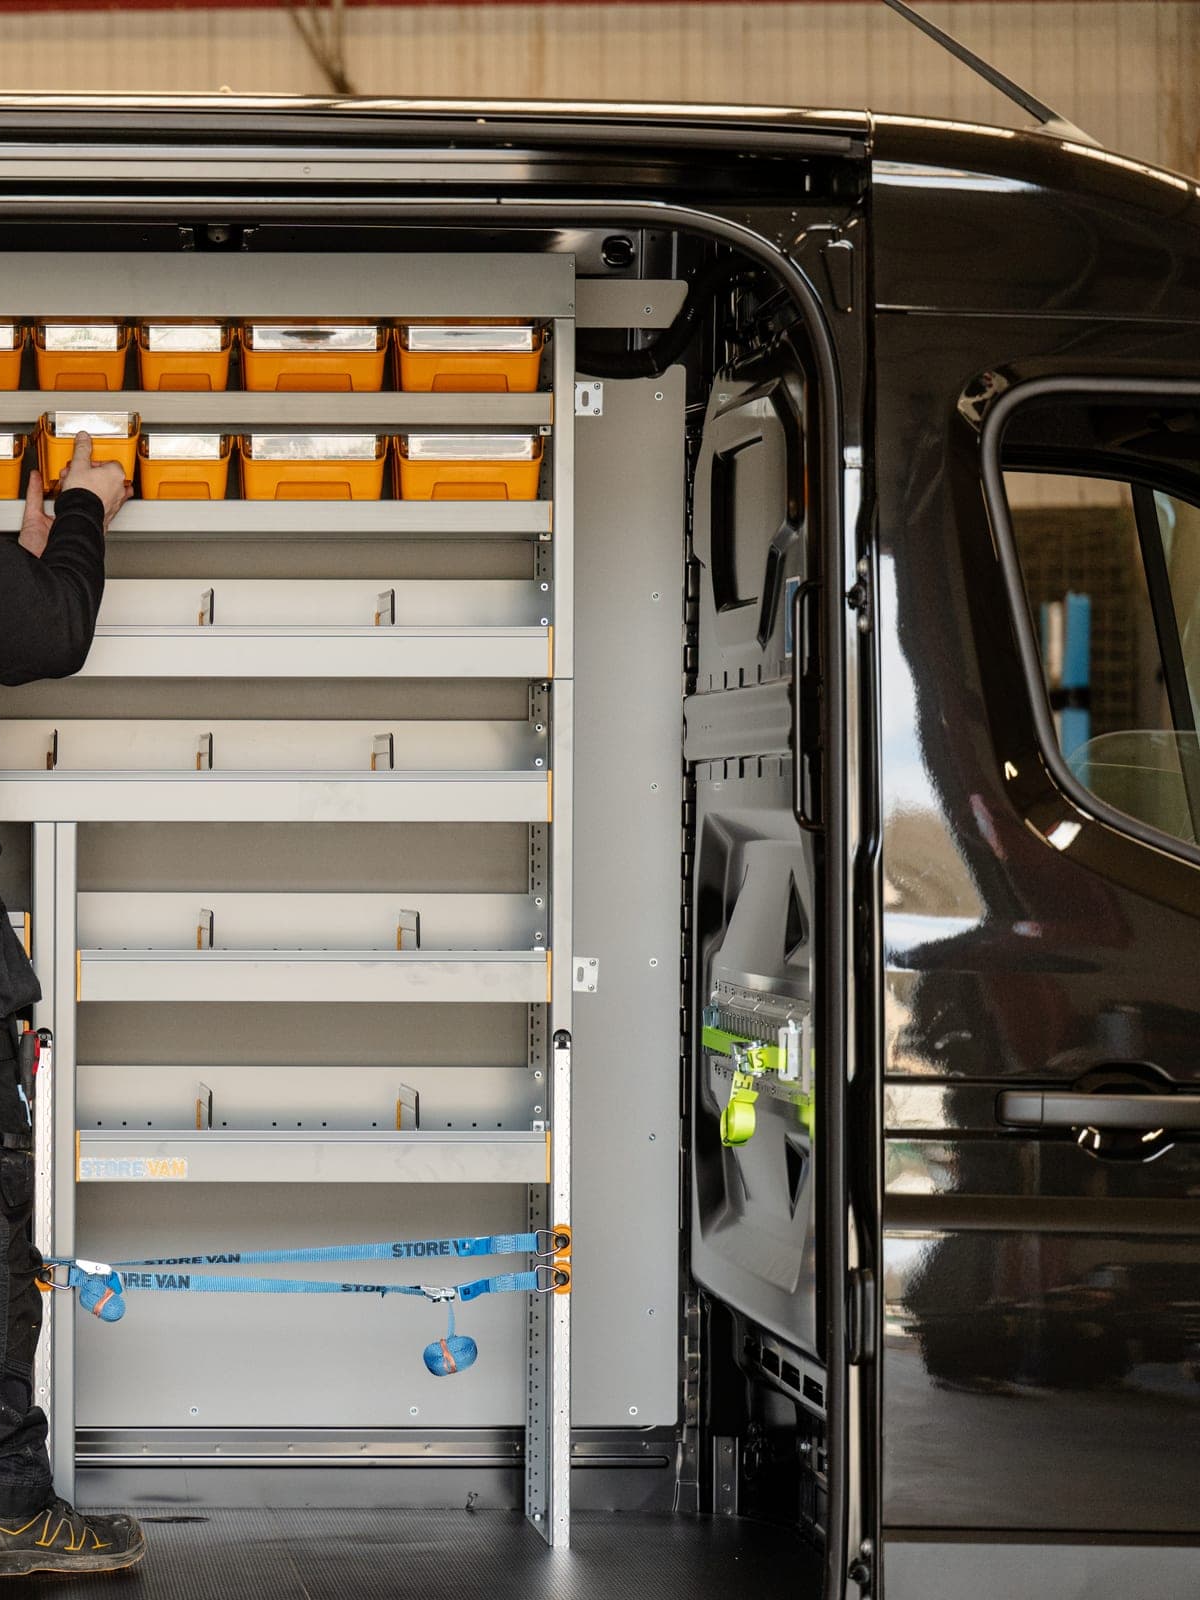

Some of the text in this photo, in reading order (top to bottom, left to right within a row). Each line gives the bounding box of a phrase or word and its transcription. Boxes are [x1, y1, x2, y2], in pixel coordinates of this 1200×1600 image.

[81, 1159, 185, 1177] STORE VAN
[392, 1240, 450, 1257] STORE
[143, 1253, 241, 1265] STORE VAN
[155, 1275, 190, 1289] VAN
